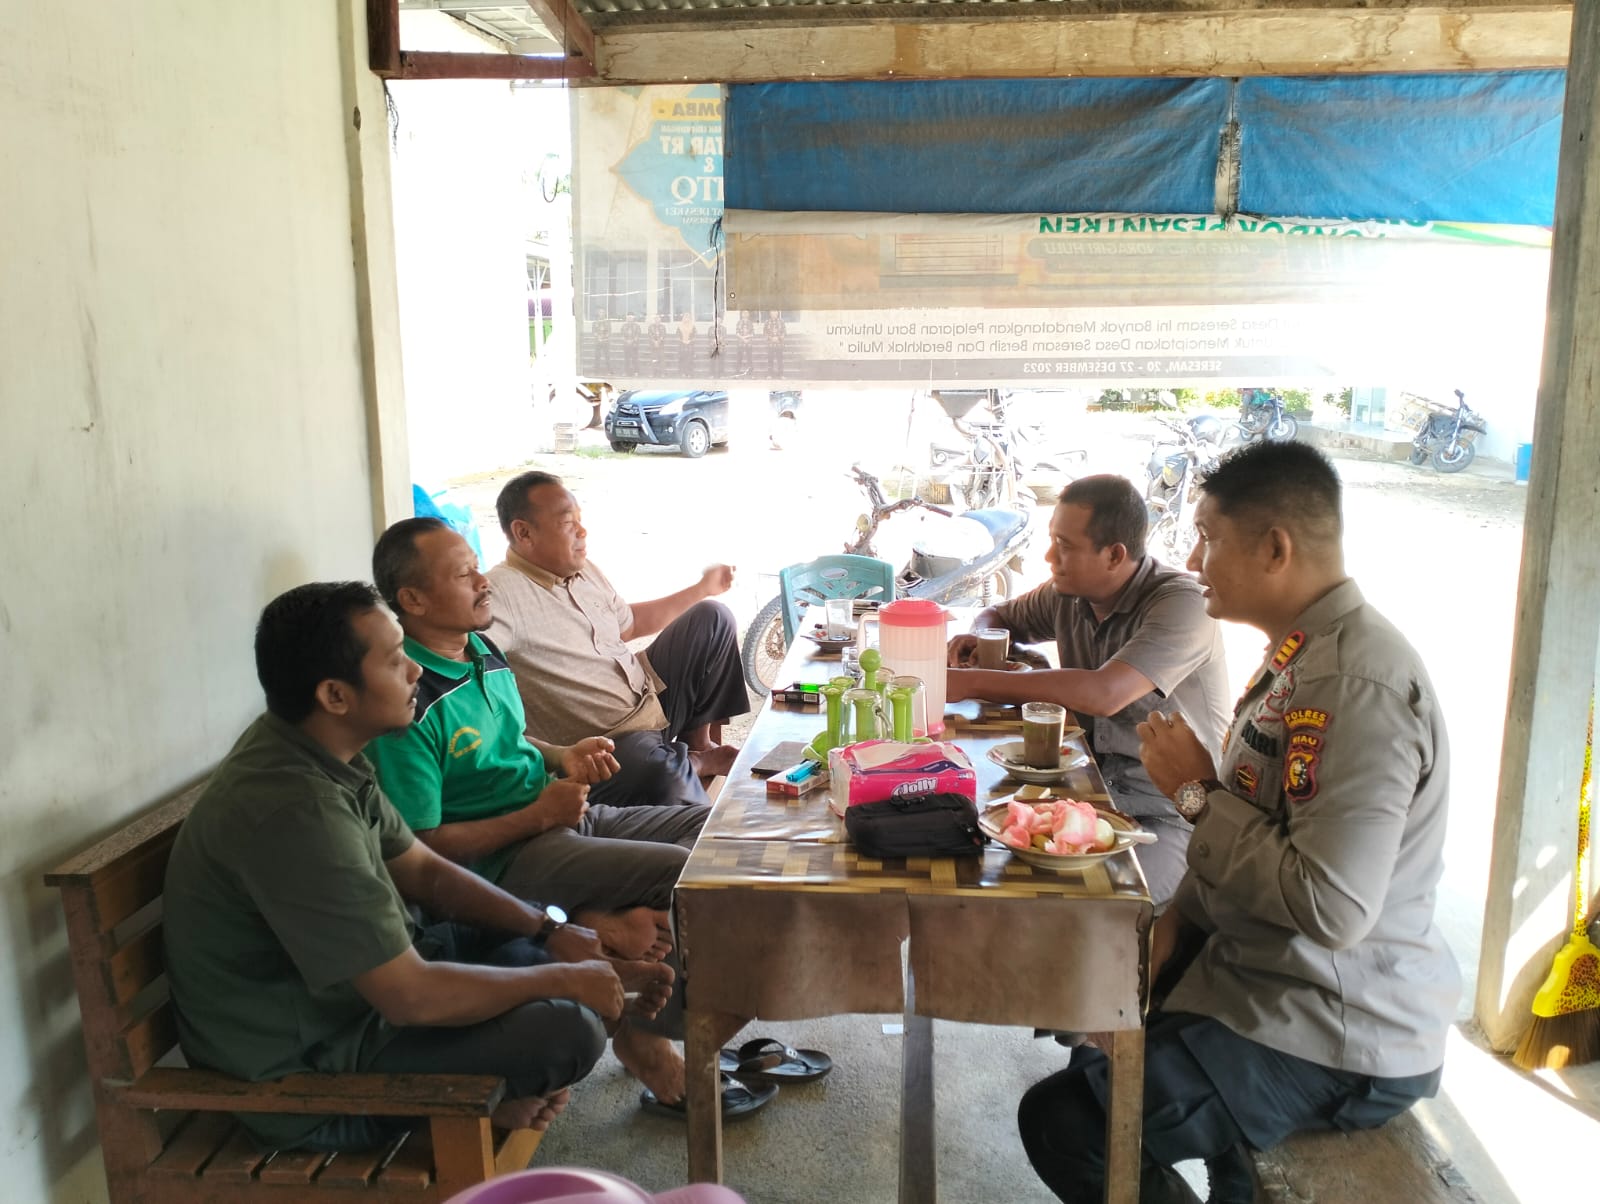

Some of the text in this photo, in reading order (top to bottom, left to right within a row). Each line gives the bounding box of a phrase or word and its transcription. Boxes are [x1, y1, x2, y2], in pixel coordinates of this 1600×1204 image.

[1284, 709, 1327, 726] POLRES
[1292, 735, 1318, 746] RIAU
[892, 778, 938, 797] Jolly
